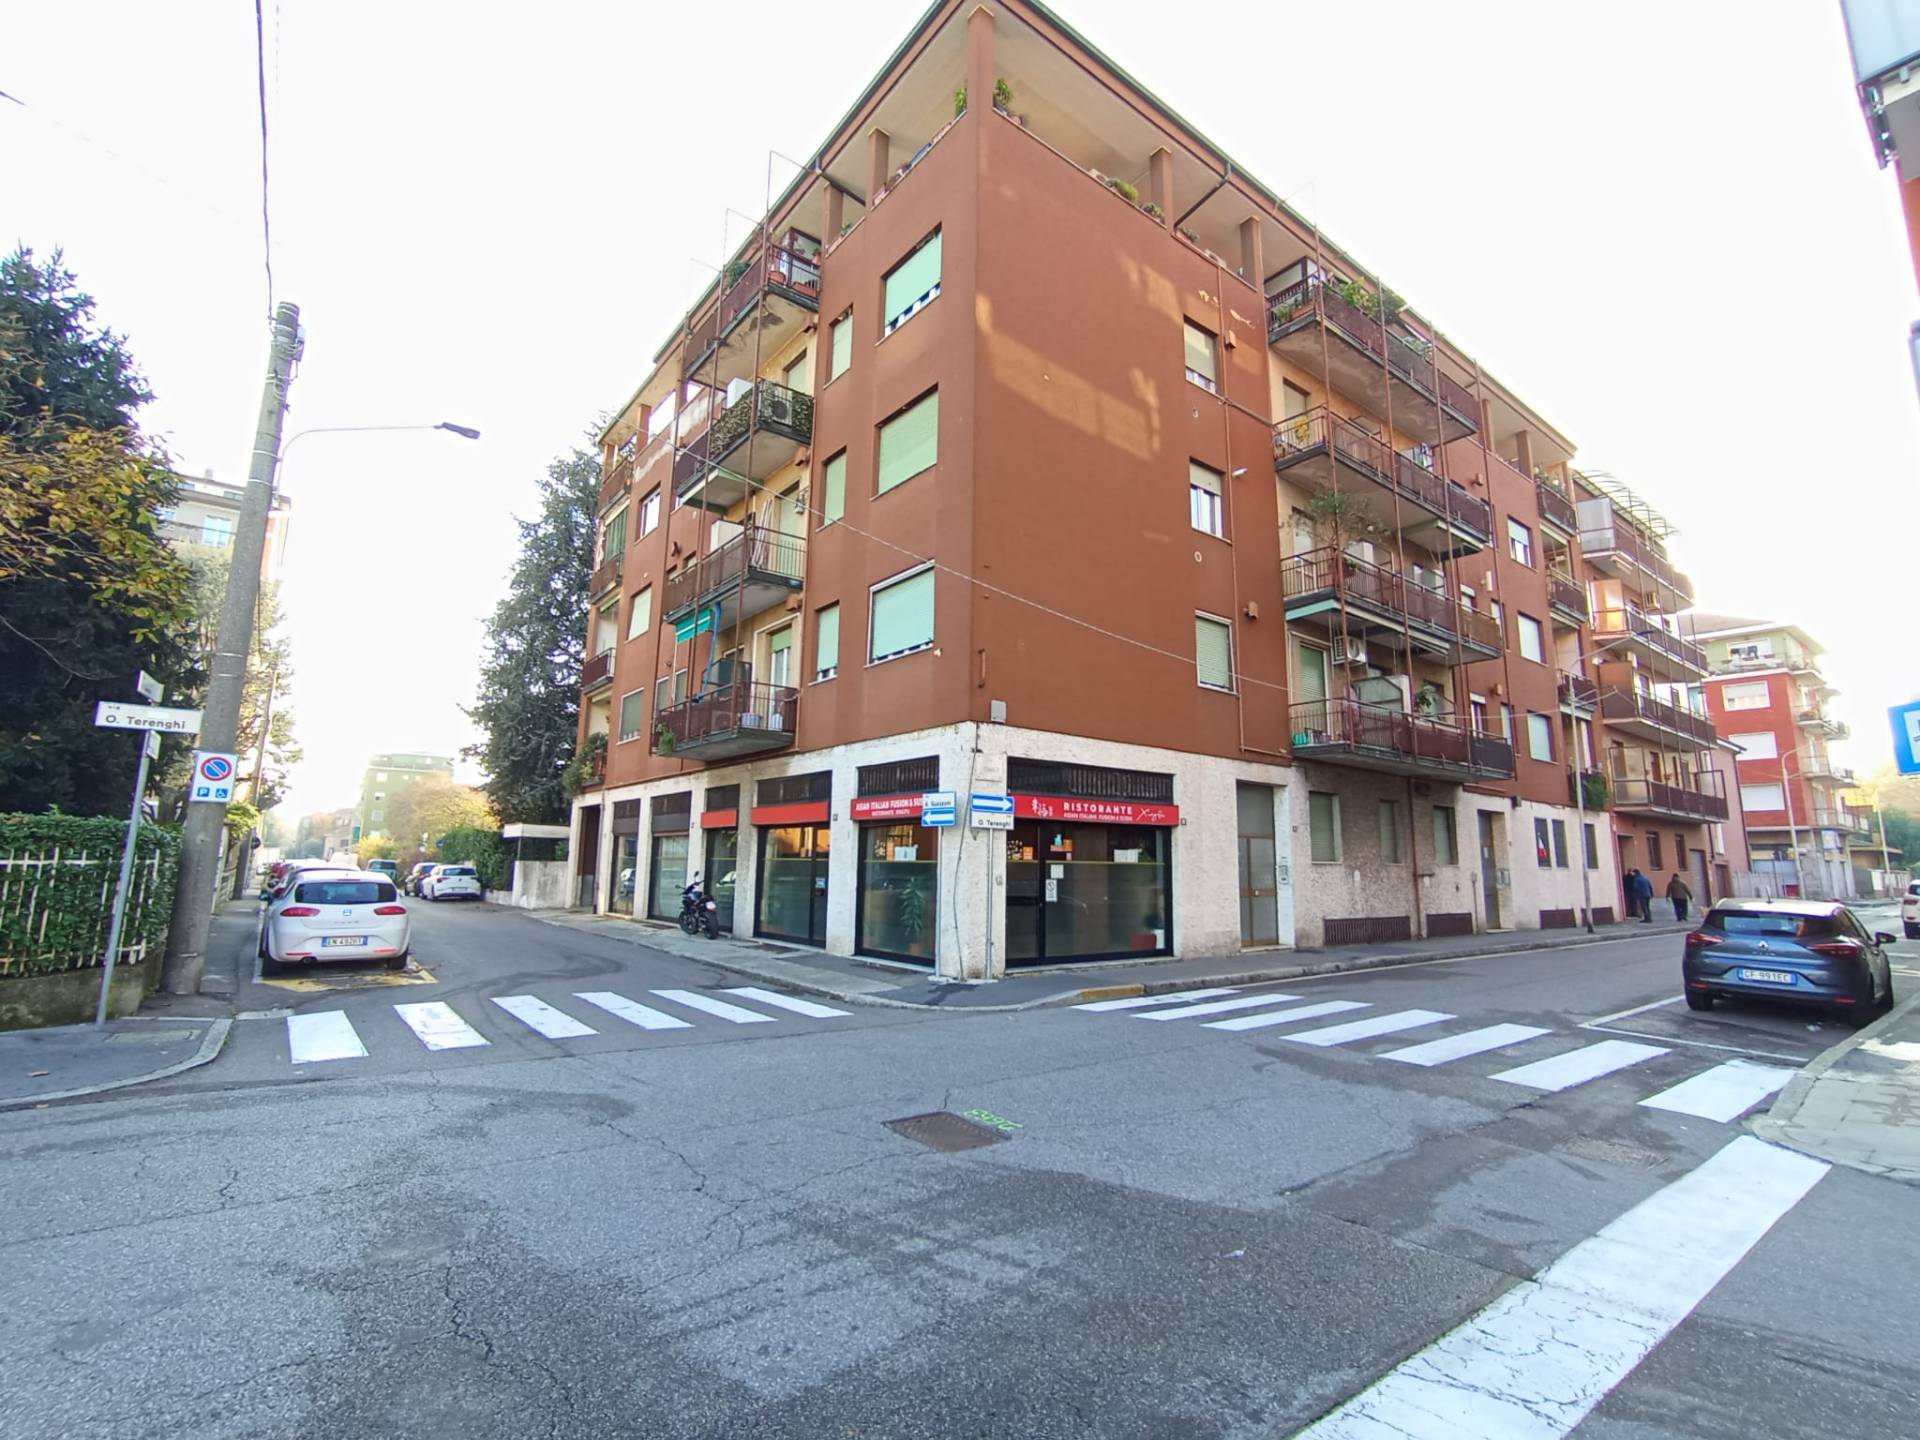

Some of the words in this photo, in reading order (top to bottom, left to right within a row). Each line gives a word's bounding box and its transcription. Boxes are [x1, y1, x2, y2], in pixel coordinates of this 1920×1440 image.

[105, 714, 121, 724] O.
[126, 716, 186, 729] Terenghi
[856, 802, 870, 811] ASIAN
[871, 800, 889, 809] ITALIAN
[890, 799, 909, 808] FUSION
[1063, 802, 1133, 815] RISTORANTE
[986, 820, 1011, 828] Terenghi
